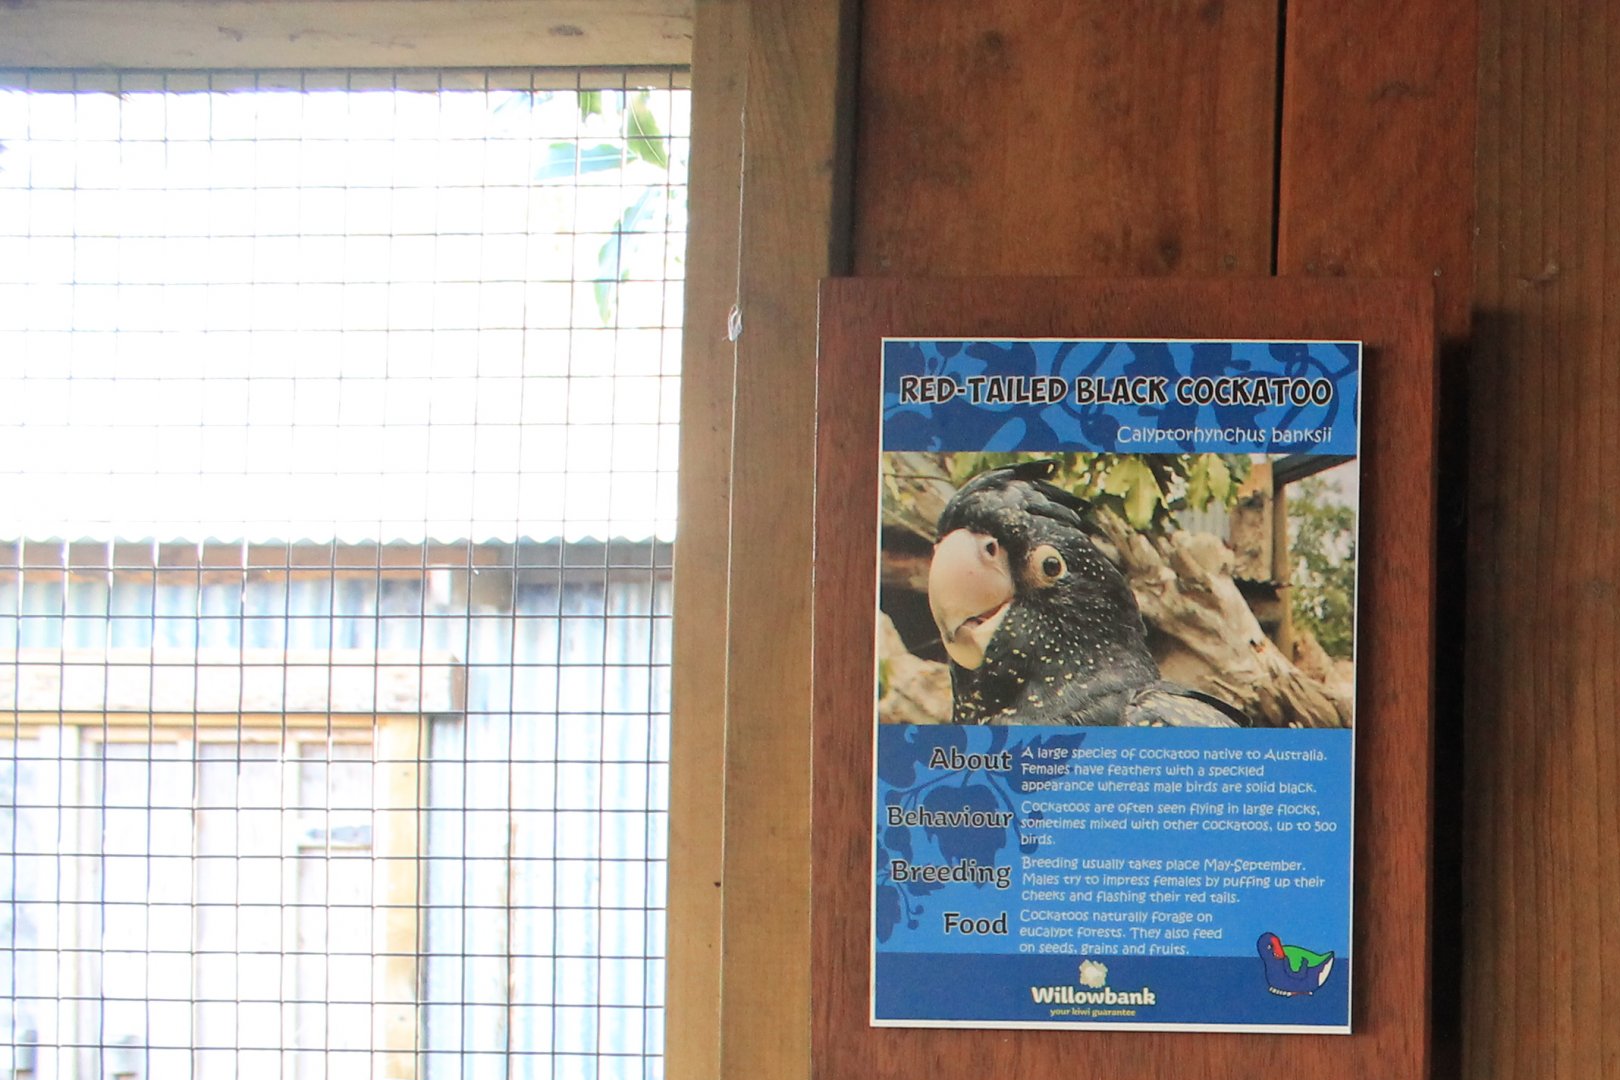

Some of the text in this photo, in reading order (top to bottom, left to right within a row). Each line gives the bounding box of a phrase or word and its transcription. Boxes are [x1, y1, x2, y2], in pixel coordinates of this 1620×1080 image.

[899, 373, 1333, 407] RED-TAILED BLACK COCKATOO
[1116, 425, 1333, 444] Calyptorhynchus banksii
[928, 745, 1013, 771] About
[1021, 747, 1328, 762] A large species of cockatoo native to Australia.
[1021, 780, 1317, 794] appearance whereas male birds are solid black.
[886, 804, 1014, 828] Behaviour
[1020, 833, 1056, 846] birds.
[890, 858, 1012, 890] Breeding
[1021, 856, 1306, 873] Breeding usually takes place May-September.
[943, 911, 1009, 936] Food
[1030, 985, 1156, 1005] Willowbank
[1050, 1007, 1136, 1017] your kiwi guarantee
